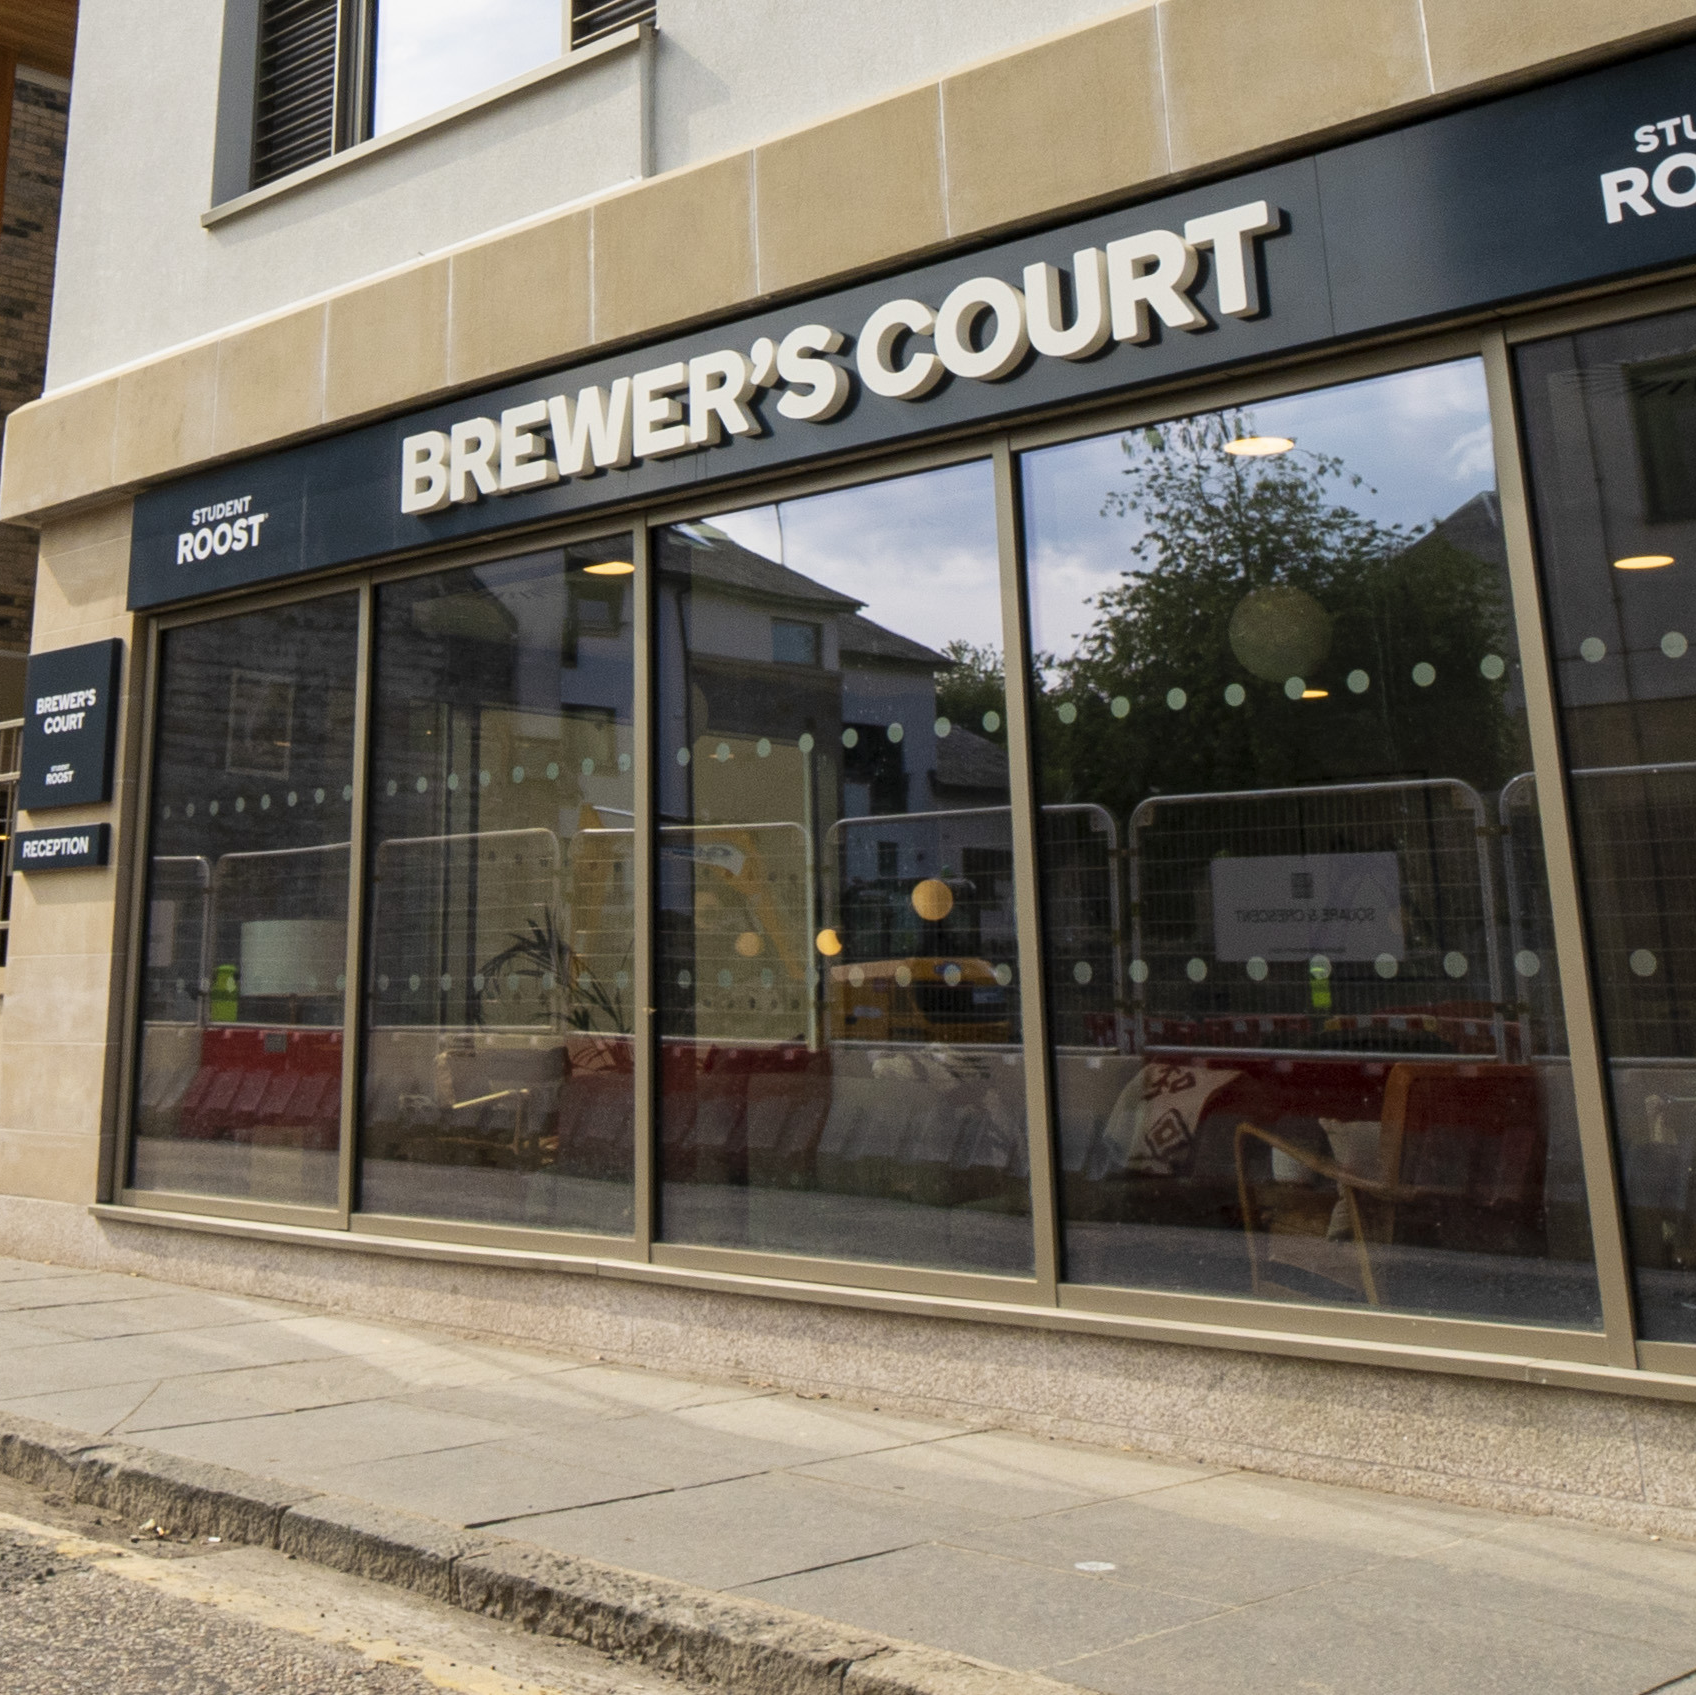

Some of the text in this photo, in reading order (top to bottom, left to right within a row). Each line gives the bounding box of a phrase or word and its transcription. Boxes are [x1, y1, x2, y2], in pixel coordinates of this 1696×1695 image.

[401, 199, 1278, 515] BREWER'S COURT
[191, 495, 253, 526] STUDENT
[176, 513, 267, 565] ROOST
[35, 687, 97, 715] BREWER'S
[43, 711, 86, 735] COURT
[45, 770, 75, 786] ROOST
[22, 835, 90, 859] RECEPTION
